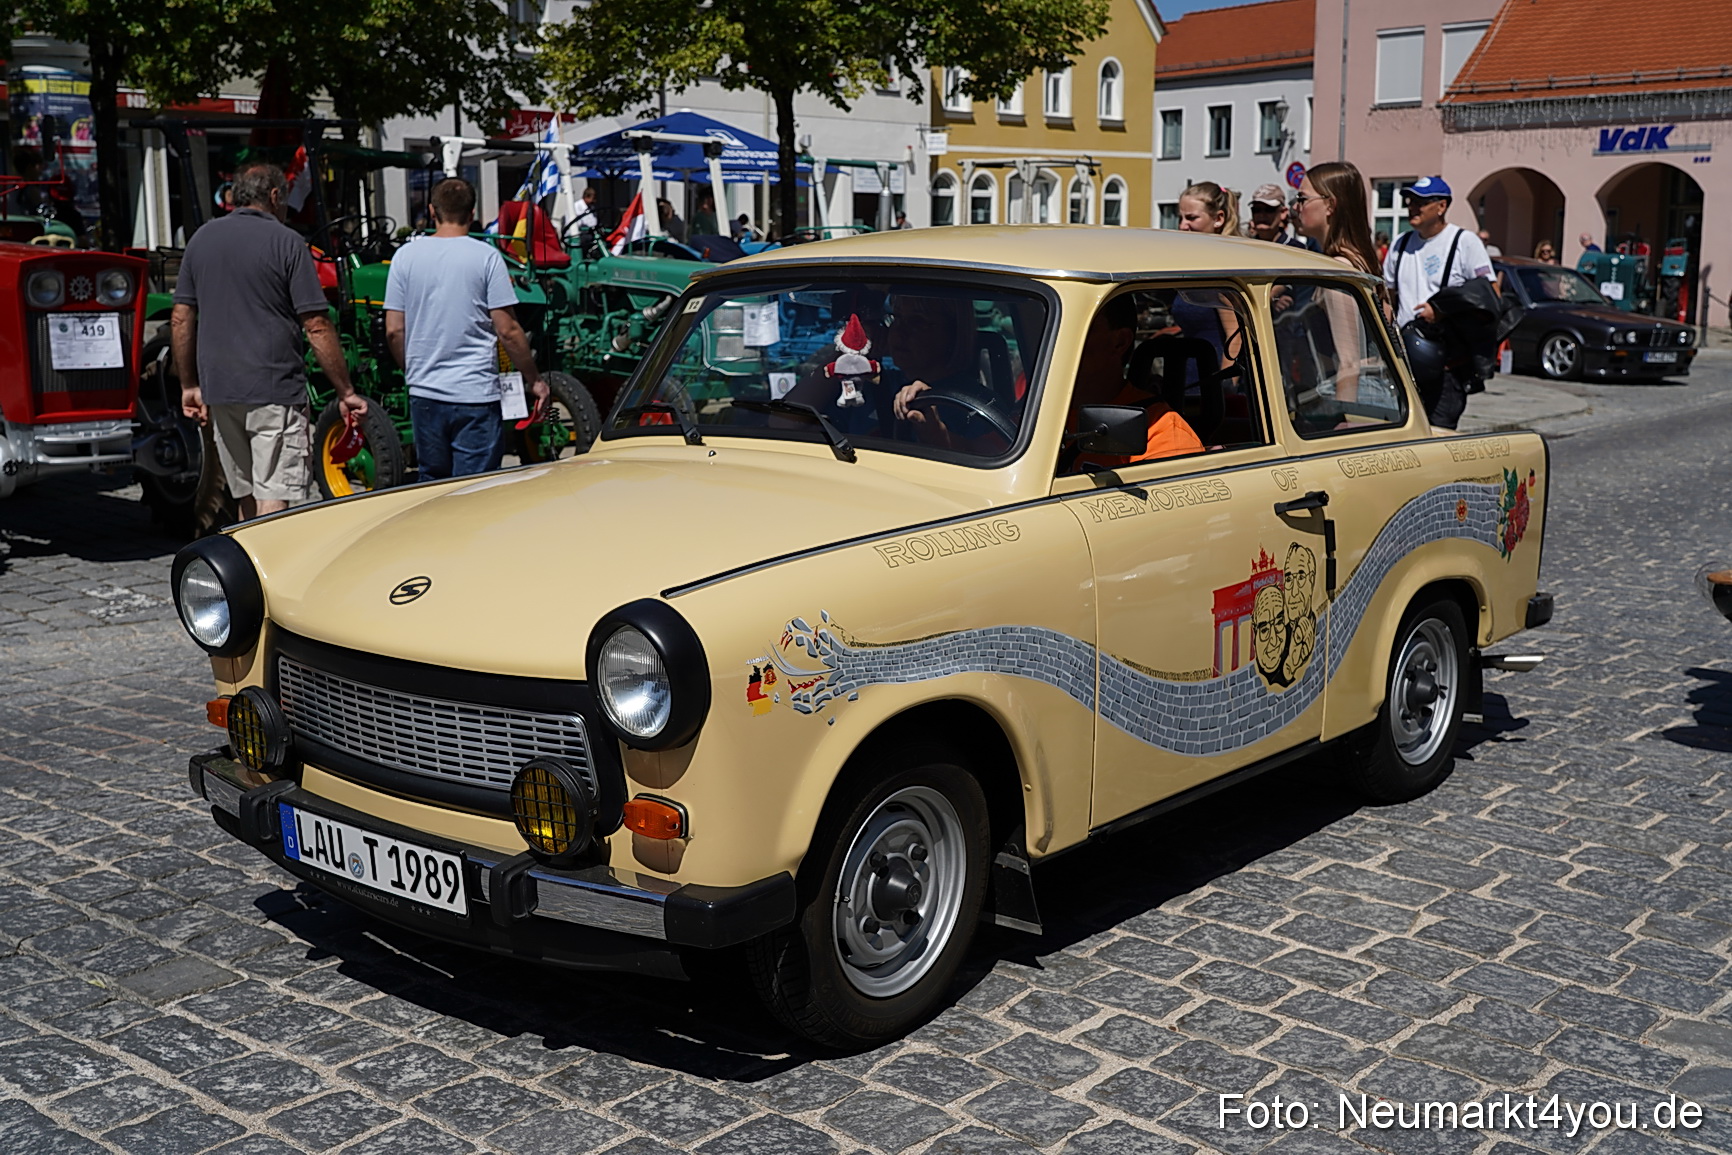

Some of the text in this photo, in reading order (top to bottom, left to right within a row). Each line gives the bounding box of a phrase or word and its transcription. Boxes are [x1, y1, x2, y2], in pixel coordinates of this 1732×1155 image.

[1598, 125, 1676, 152] VdK
[81, 324, 105, 337] 419
[872, 519, 1021, 569] ROLLING
[1080, 478, 1232, 523] MEMORIES
[1270, 466, 1299, 492] OF
[1337, 448, 1422, 478] GERMAN
[296, 813, 346, 871] LAU
[363, 836, 379, 882] T
[387, 844, 460, 905] 1989
